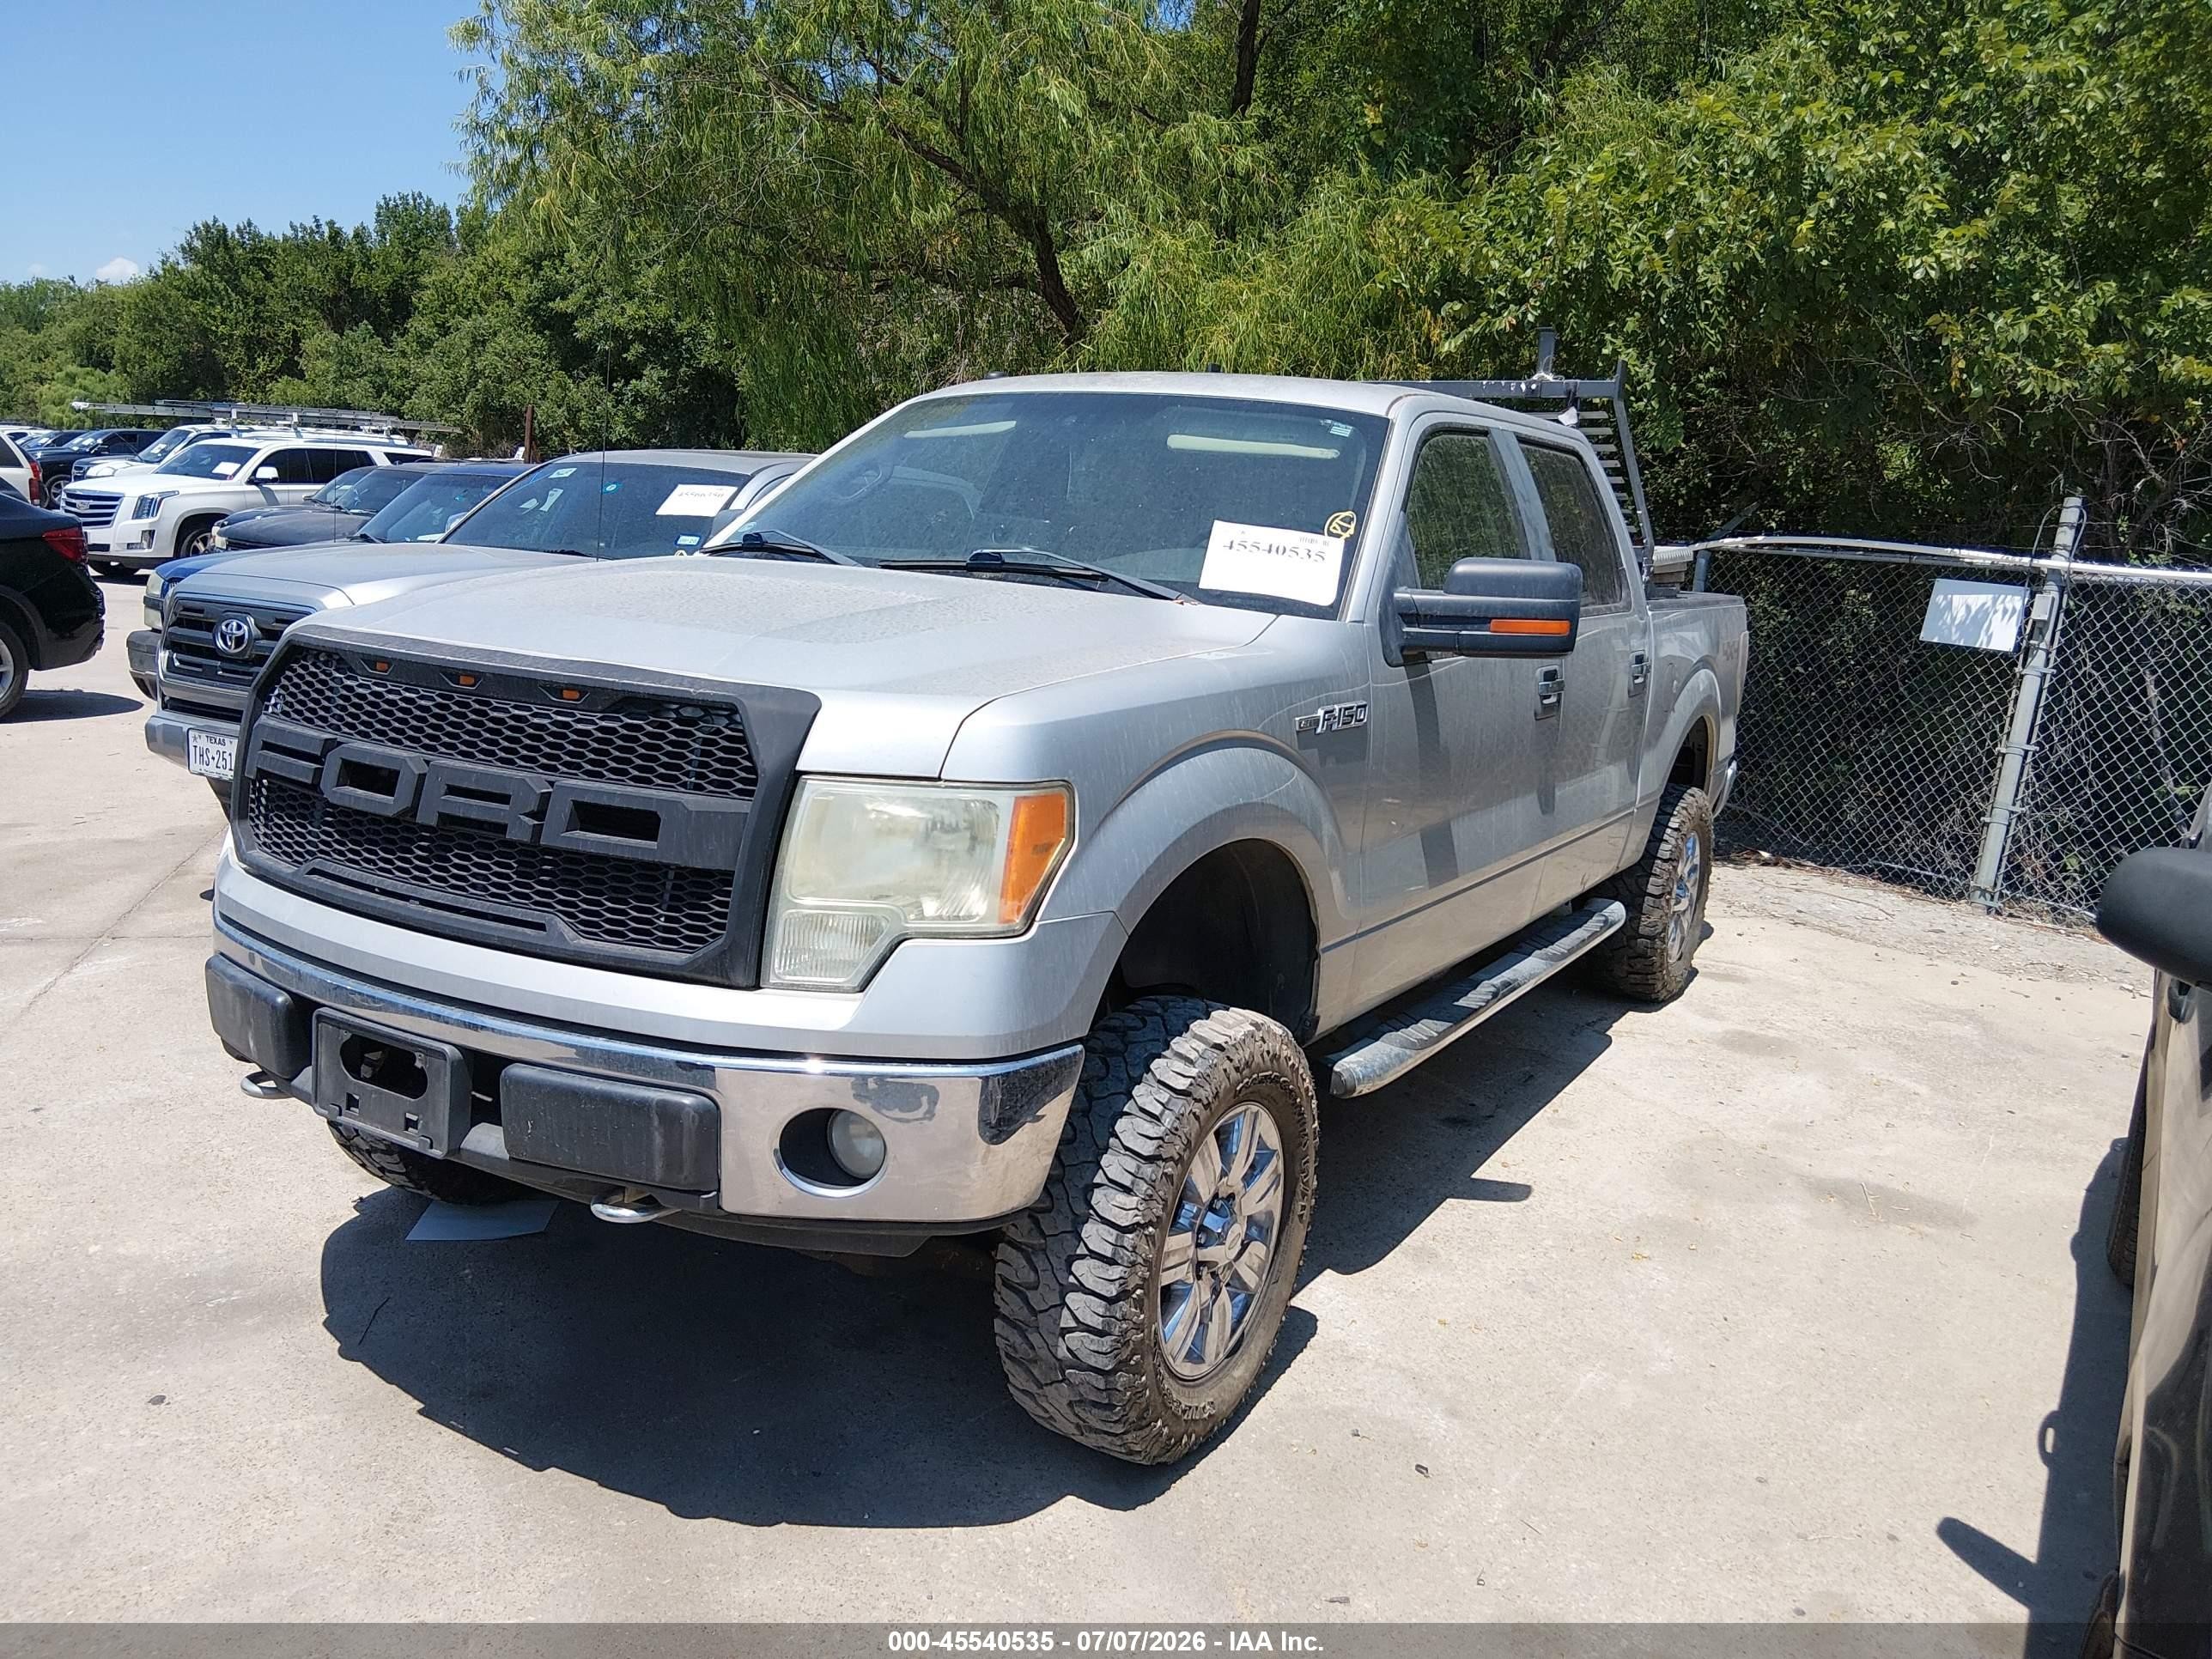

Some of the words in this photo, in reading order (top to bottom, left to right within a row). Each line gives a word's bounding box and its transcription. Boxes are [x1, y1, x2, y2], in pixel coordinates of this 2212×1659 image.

[1224, 540, 1325, 562] 45540535
[1316, 701, 1369, 733] F-150
[206, 736, 226, 746] TEXAS
[245, 716, 697, 866] FORD
